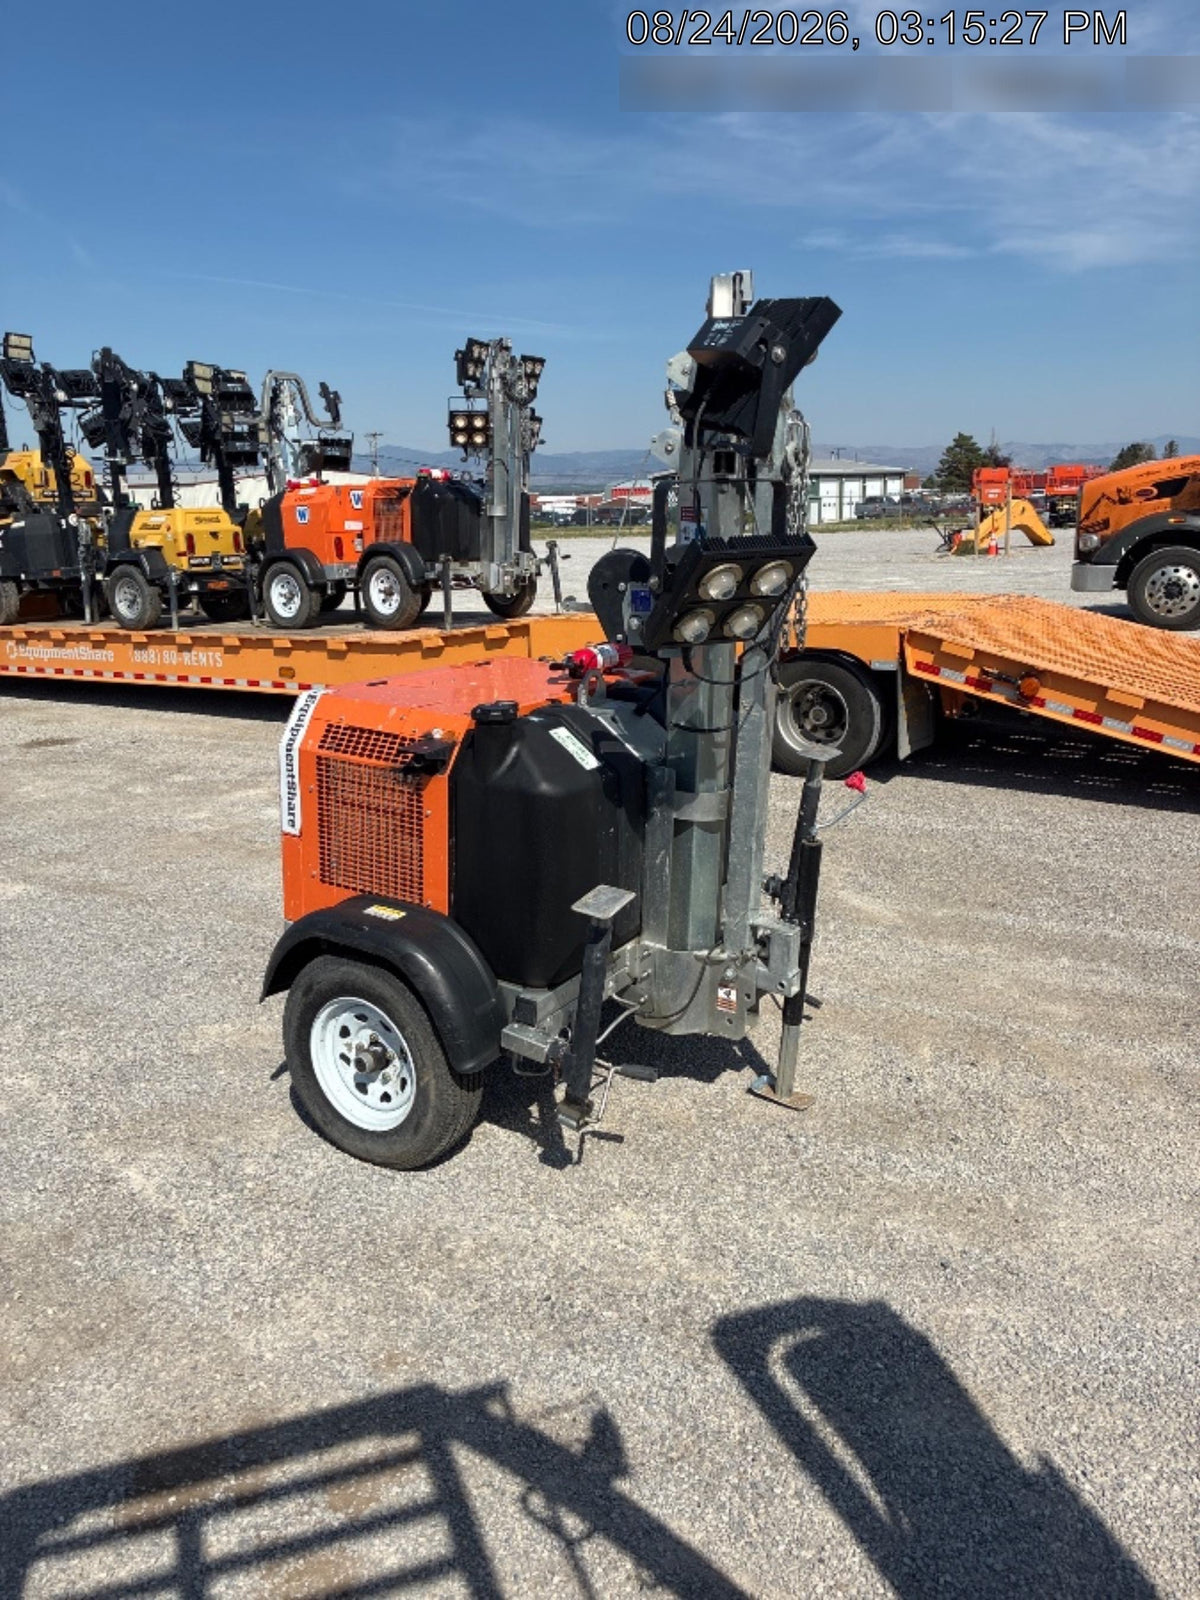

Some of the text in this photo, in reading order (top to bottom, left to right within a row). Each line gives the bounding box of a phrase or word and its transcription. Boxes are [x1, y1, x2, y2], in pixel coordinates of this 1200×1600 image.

[19, 644, 114, 662] EquipmentShare
[163, 649, 223, 667] 80-RENTS
[285, 693, 318, 828] EquipmentShare
